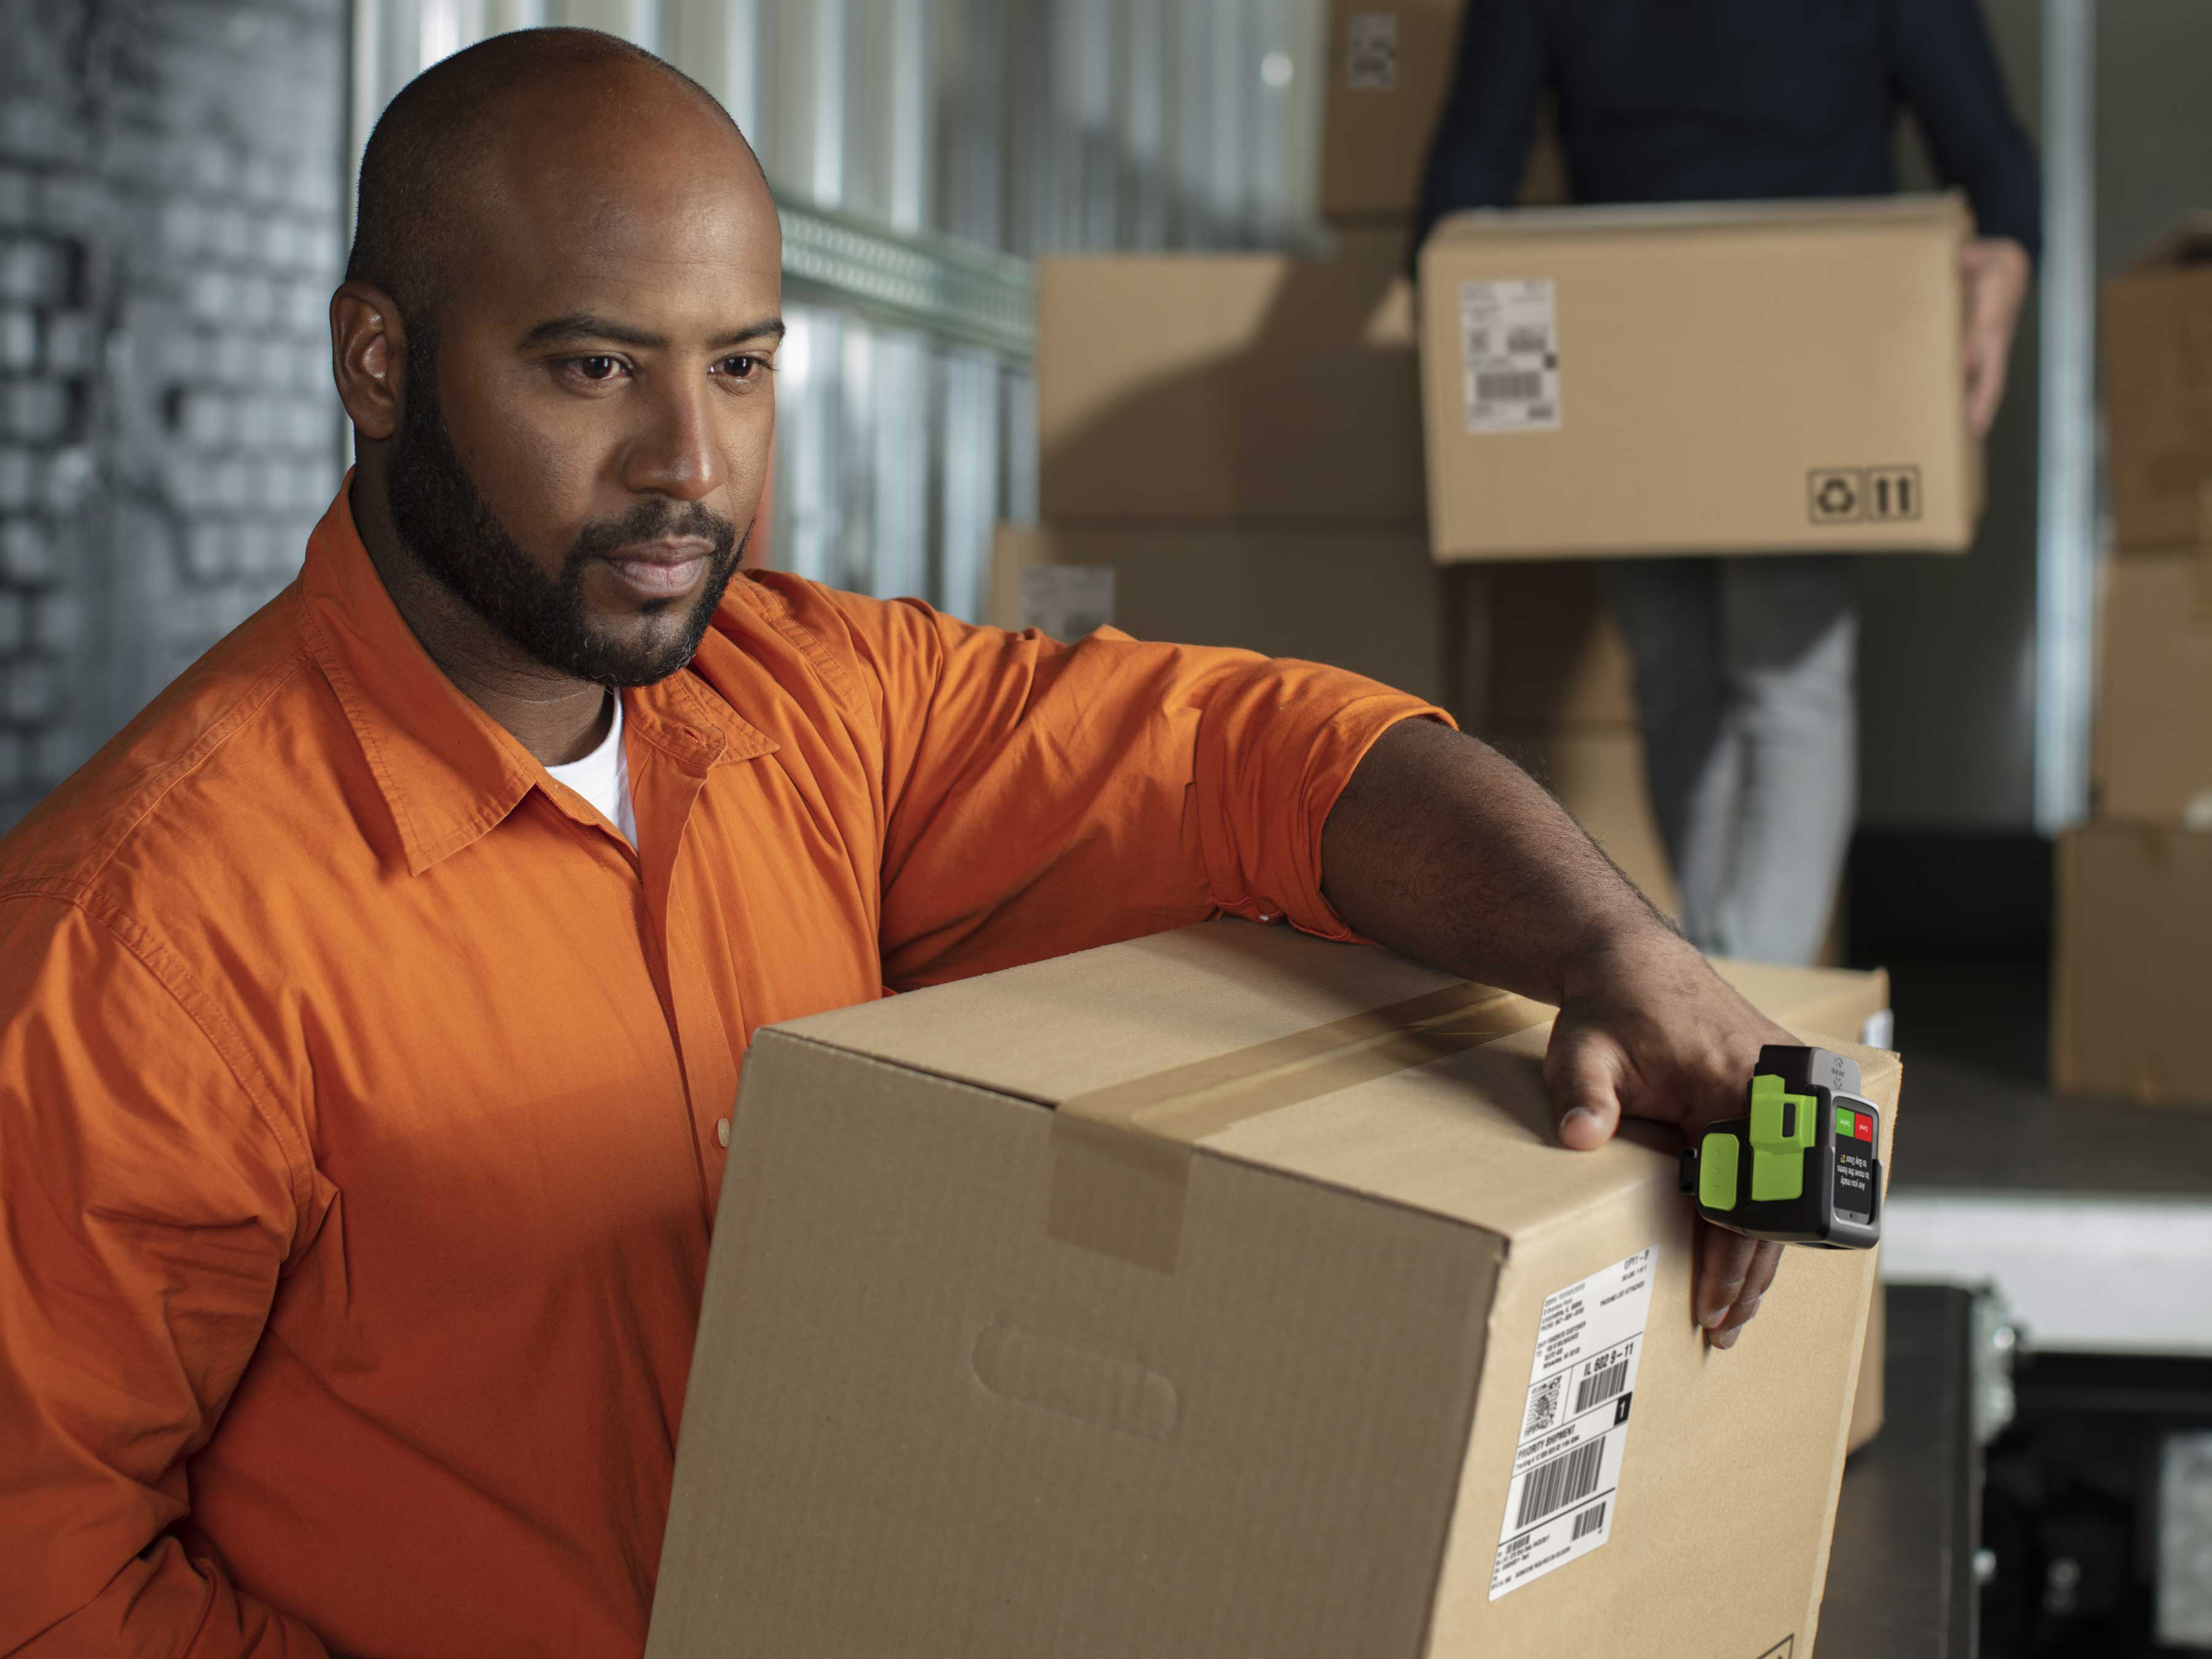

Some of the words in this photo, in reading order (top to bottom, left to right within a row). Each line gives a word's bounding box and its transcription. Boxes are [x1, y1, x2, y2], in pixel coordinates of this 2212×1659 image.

[1840, 1155, 1846, 1163] 2?
[1846, 1156, 1855, 1166] Door
[1837, 1164, 1848, 1176] items
[1855, 1169, 1865, 1178] move
[1840, 1175, 1851, 1187] ready
[1584, 1362, 1591, 1377] IL
[1594, 1353, 1609, 1372] 602
[1620, 1401, 1626, 1418] 1
[1517, 1439, 1545, 1462] PRIORITY
[1545, 1424, 1576, 1447] SHIPMENT
